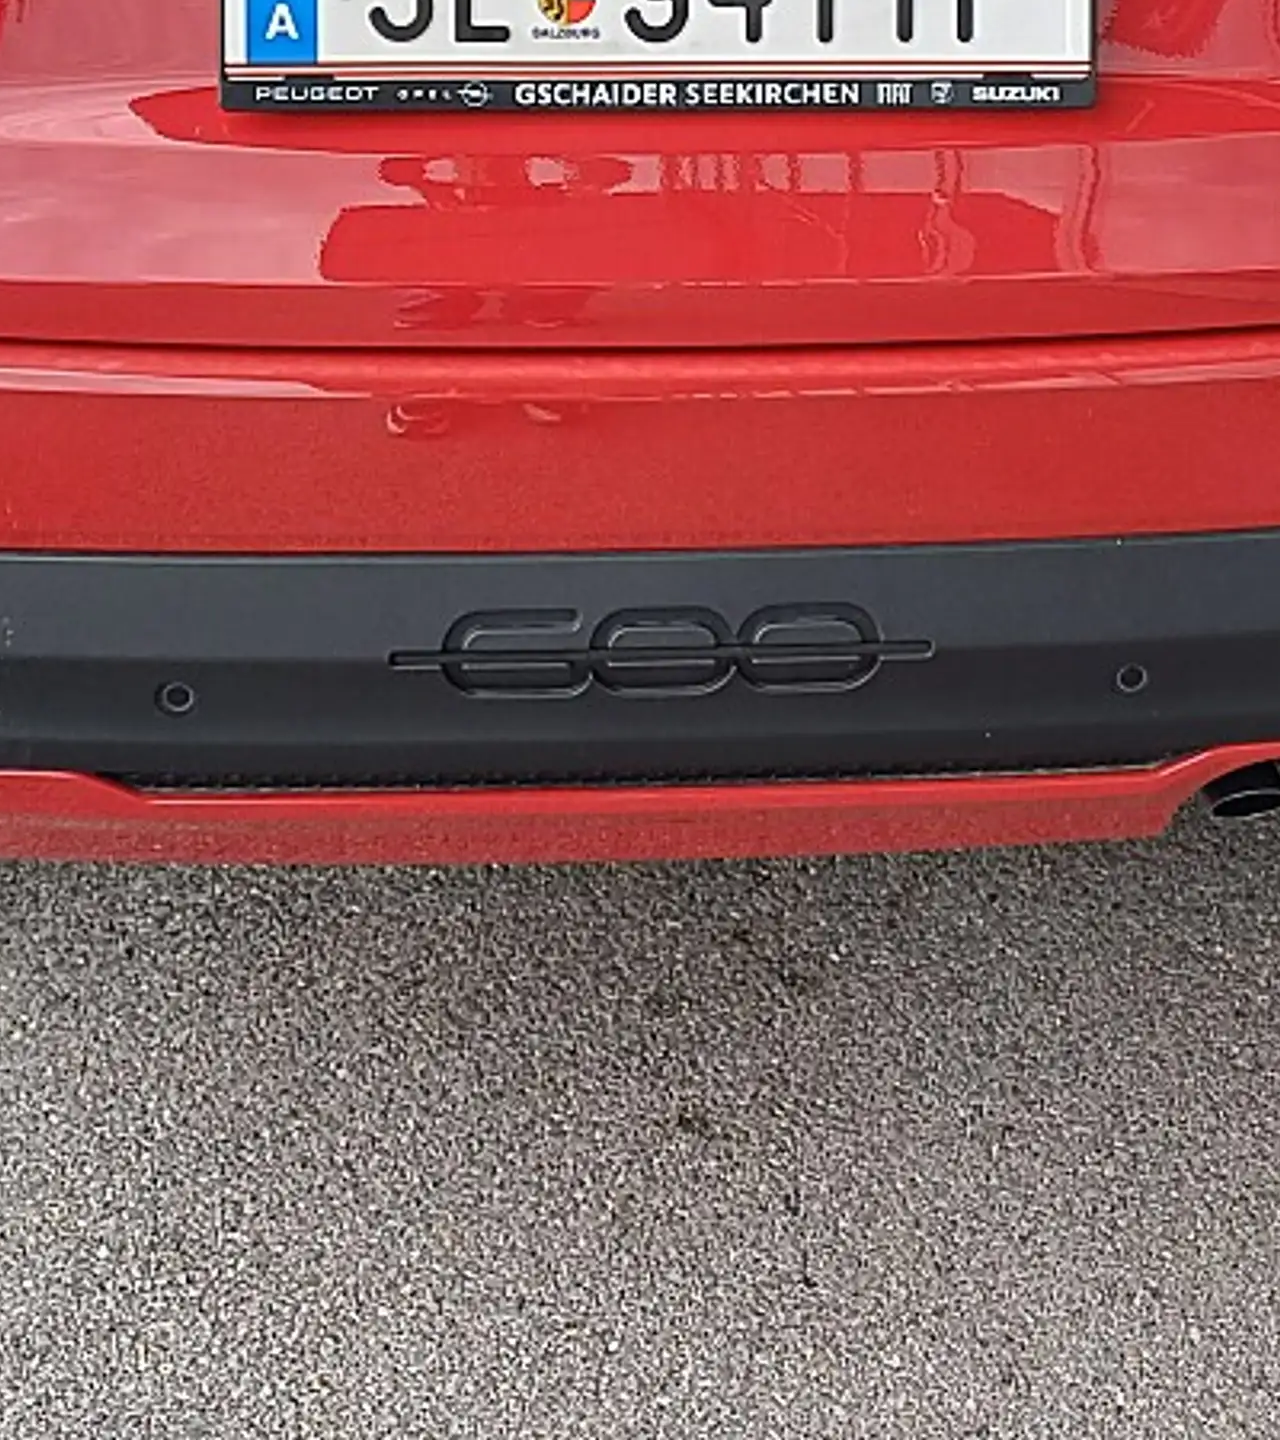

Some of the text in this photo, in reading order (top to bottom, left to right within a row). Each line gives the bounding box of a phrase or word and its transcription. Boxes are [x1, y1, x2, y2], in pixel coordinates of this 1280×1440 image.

[264, 4, 300, 41] A
[256, 86, 379, 101] PEUGEOT
[514, 82, 677, 106] GSCHAIDER
[685, 82, 860, 106] SEEKIRCHEN
[972, 86, 1061, 102] SUZUKI
[440, 600, 885, 699] 600
